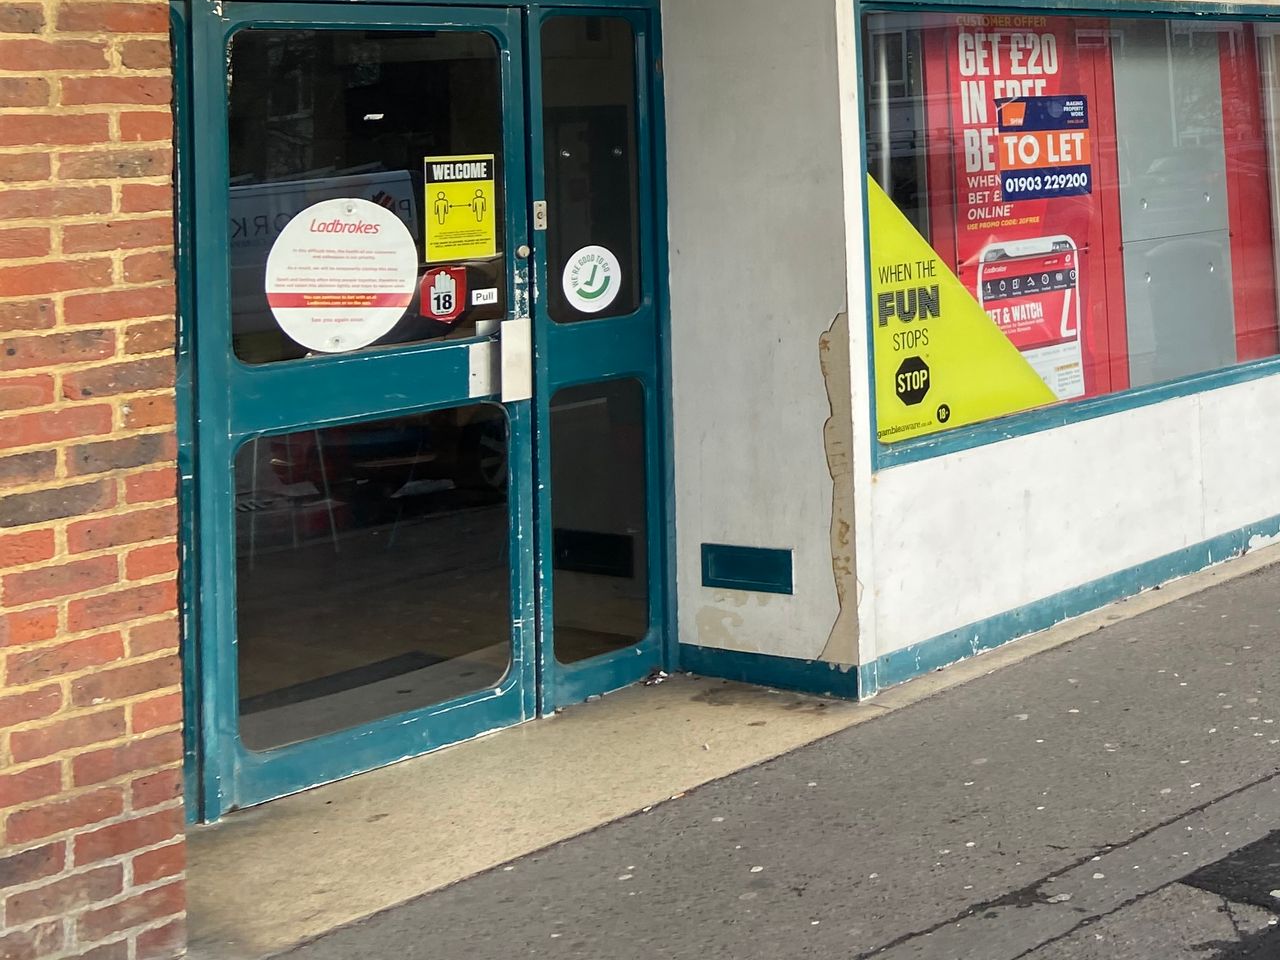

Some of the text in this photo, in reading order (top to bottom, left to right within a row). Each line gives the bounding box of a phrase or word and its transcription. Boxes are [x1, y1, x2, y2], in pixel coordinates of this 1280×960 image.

[956, 16, 1047, 27] CUSTOMER OFFER
[958, 33, 1058, 76] GET £20
[961, 80, 987, 124] IN
[1003, 133, 1085, 165] TO LET
[432, 162, 487, 180] WELCOME
[967, 175, 1001, 188] WHEN
[1005, 173, 1087, 192] 01903 229200
[968, 192, 990, 205] BET
[310, 218, 380, 234] Ladbrokes
[578, 254, 595, 266] GOOD
[879, 260, 936, 284] WHEN THE
[433, 294, 452, 310] 18
[476, 292, 494, 301] Pull
[878, 284, 940, 328] FUN
[1011, 302, 1043, 321] WATCH
[893, 328, 929, 351] STOPS
[897, 369, 928, 393] STOP
